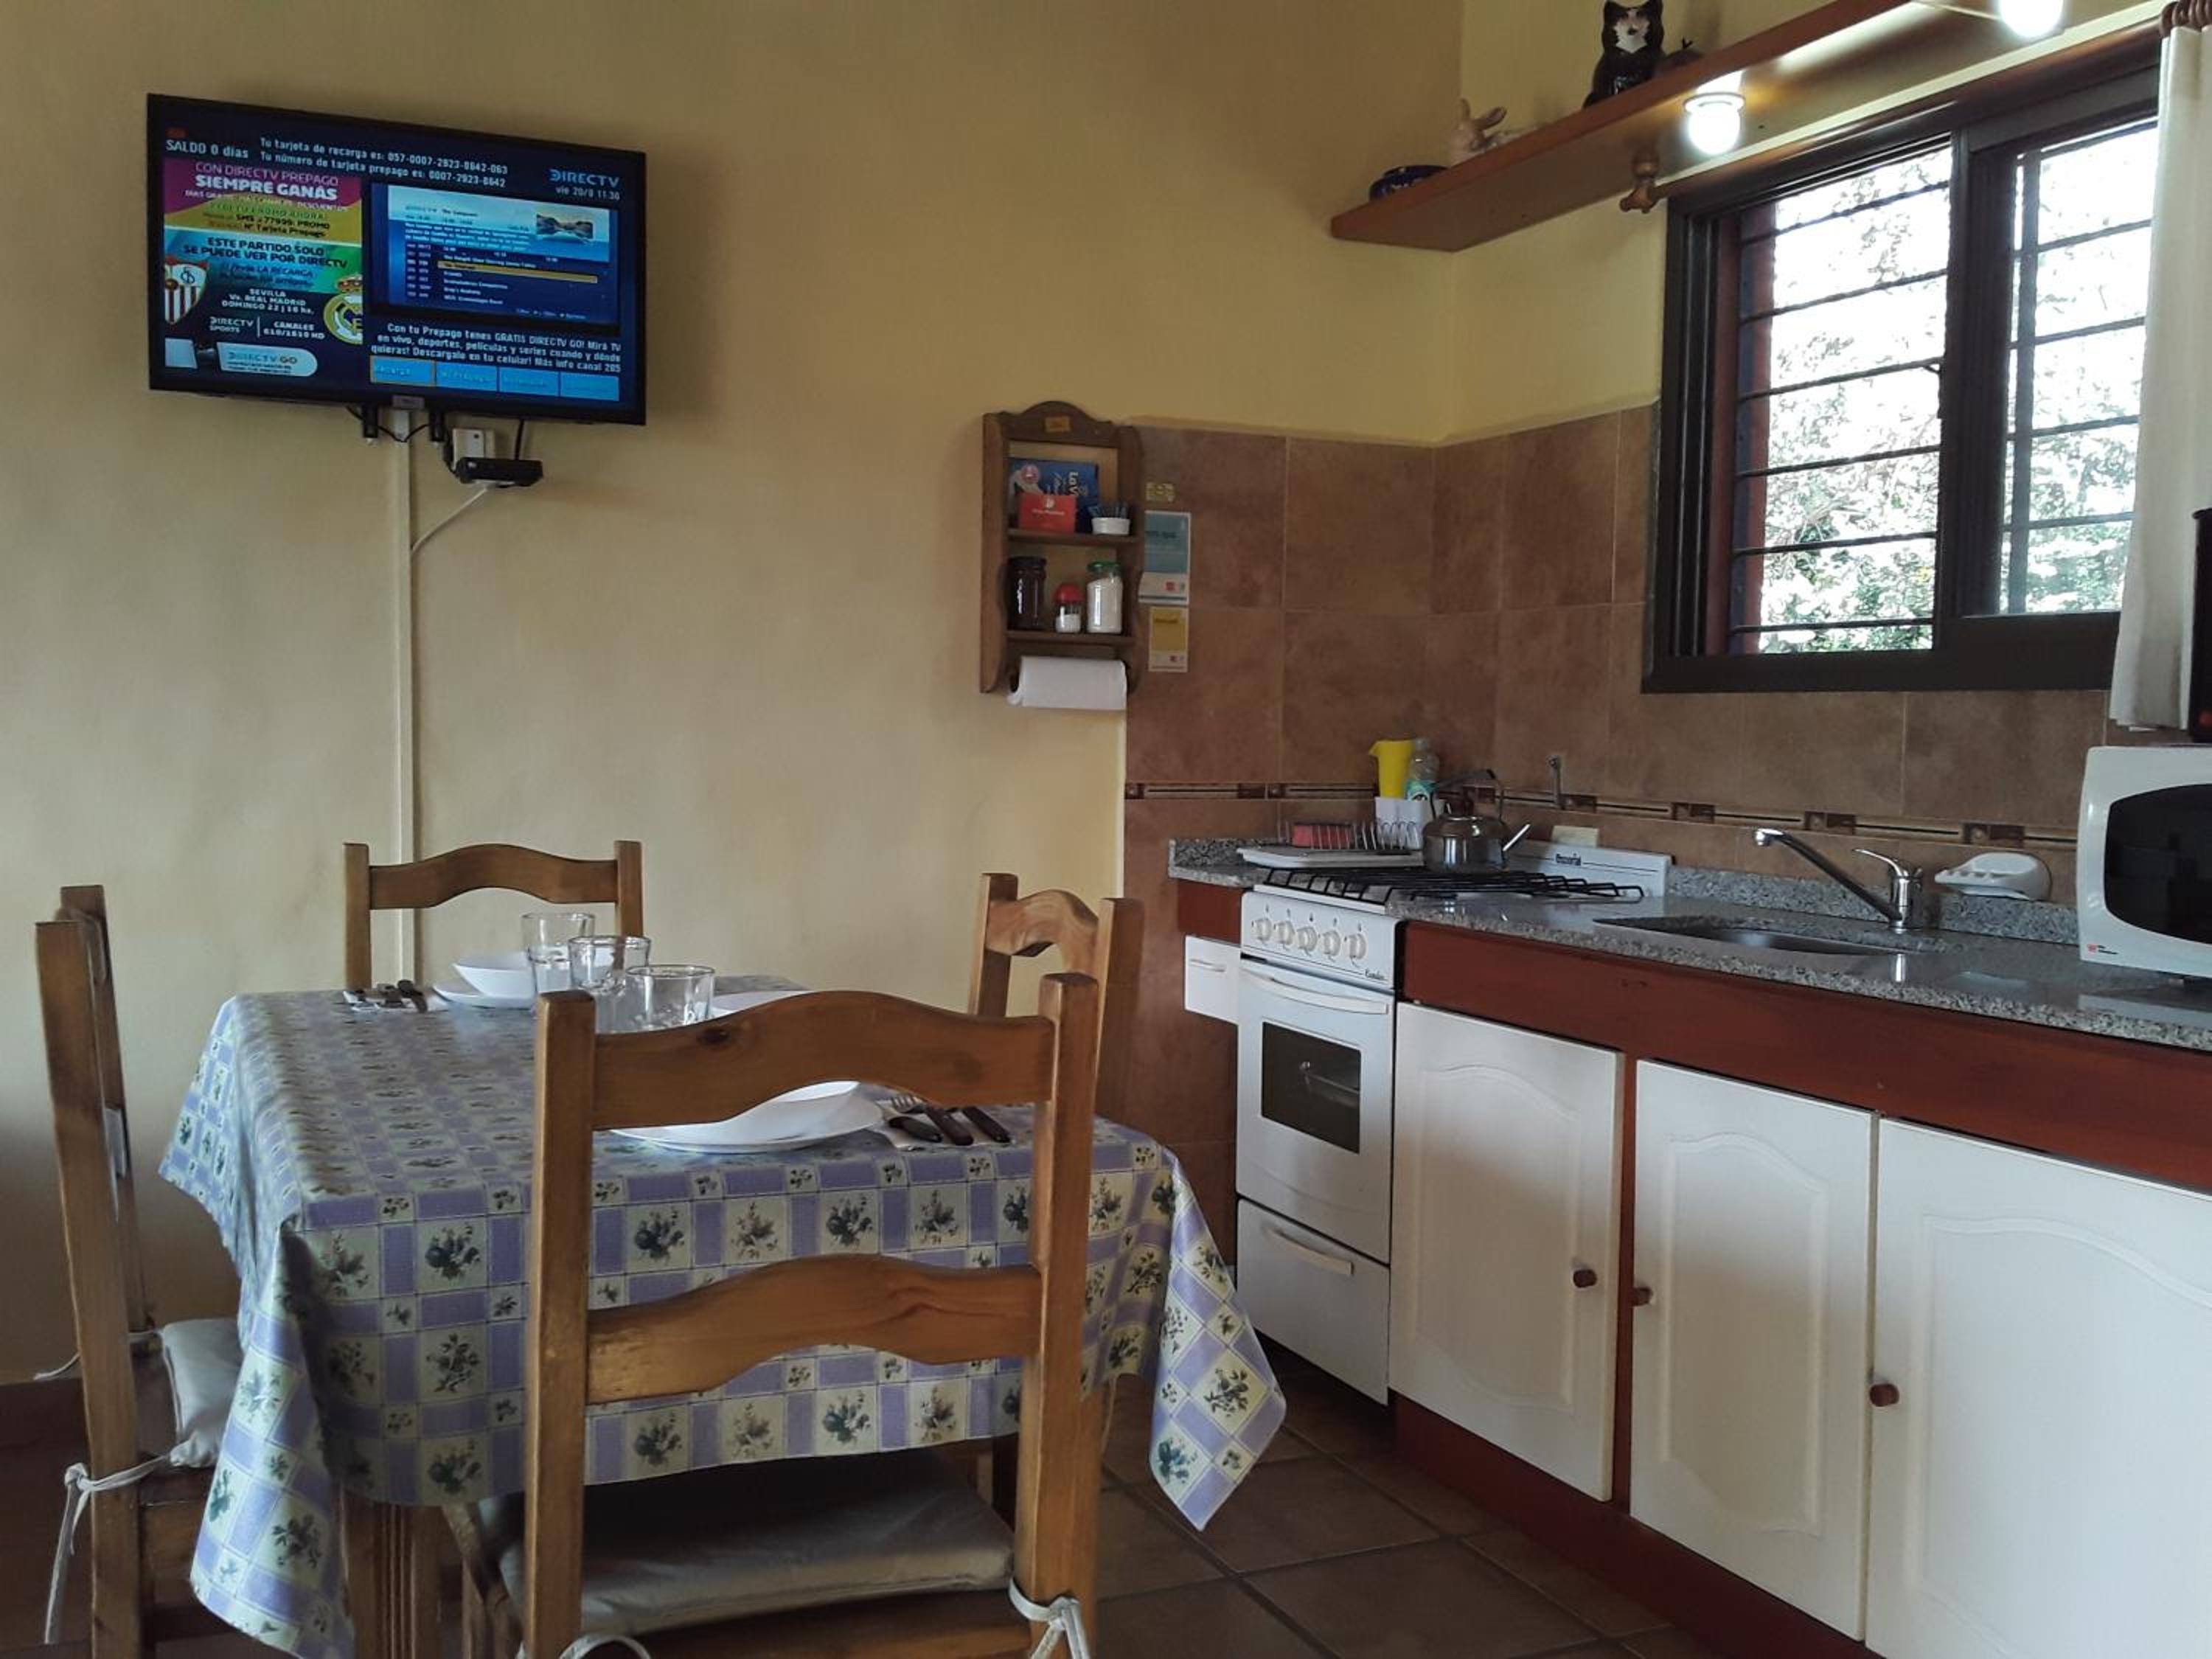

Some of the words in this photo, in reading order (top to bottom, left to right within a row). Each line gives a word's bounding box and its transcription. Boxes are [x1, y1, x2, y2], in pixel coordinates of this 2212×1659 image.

[167, 139, 206, 153] SALDO
[260, 138, 271, 147] Tu
[274, 139, 309, 151] tarjeta
[313, 145, 325, 153] de
[329, 147, 367, 159] recarga
[195, 161, 222, 174] CON
[225, 165, 279, 179] DIRECTV
[282, 170, 338, 185] PREPAGO
[260, 151, 272, 161] Tu
[316, 158, 328, 167] de
[332, 159, 366, 172] tarjeta
[369, 166, 408, 178] prepago
[195, 174, 274, 194] SIEMPRE
[549, 169, 619, 188] DIRECTV
[208, 237, 237, 248] ESTE
[240, 240, 291, 253] PARTIDO
[184, 245, 198, 254] SE
[201, 246, 240, 257] PUEDE
[244, 249, 268, 260] VER
[270, 252, 296, 263] POR
[298, 256, 348, 269] DIRECTV
[244, 295, 268, 303] REAL
[270, 297, 306, 306] MADRID
[249, 288, 286, 297] SEVILLA
[222, 300, 265, 310] DOMINGO
[209, 316, 254, 328] DIRECTV
[388, 323, 406, 333] Con
[409, 324, 420, 334] tu
[422, 326, 462, 338] Prepago
[495, 333, 526, 344] GRATIS
[529, 335, 567, 347] DIRECTV
[279, 356, 298, 365] GO
[519, 347, 546, 356] series
[550, 349, 582, 359] cuando
[483, 352, 494, 361] tu
[555, 359, 574, 369] info
[577, 361, 602, 372] canal
